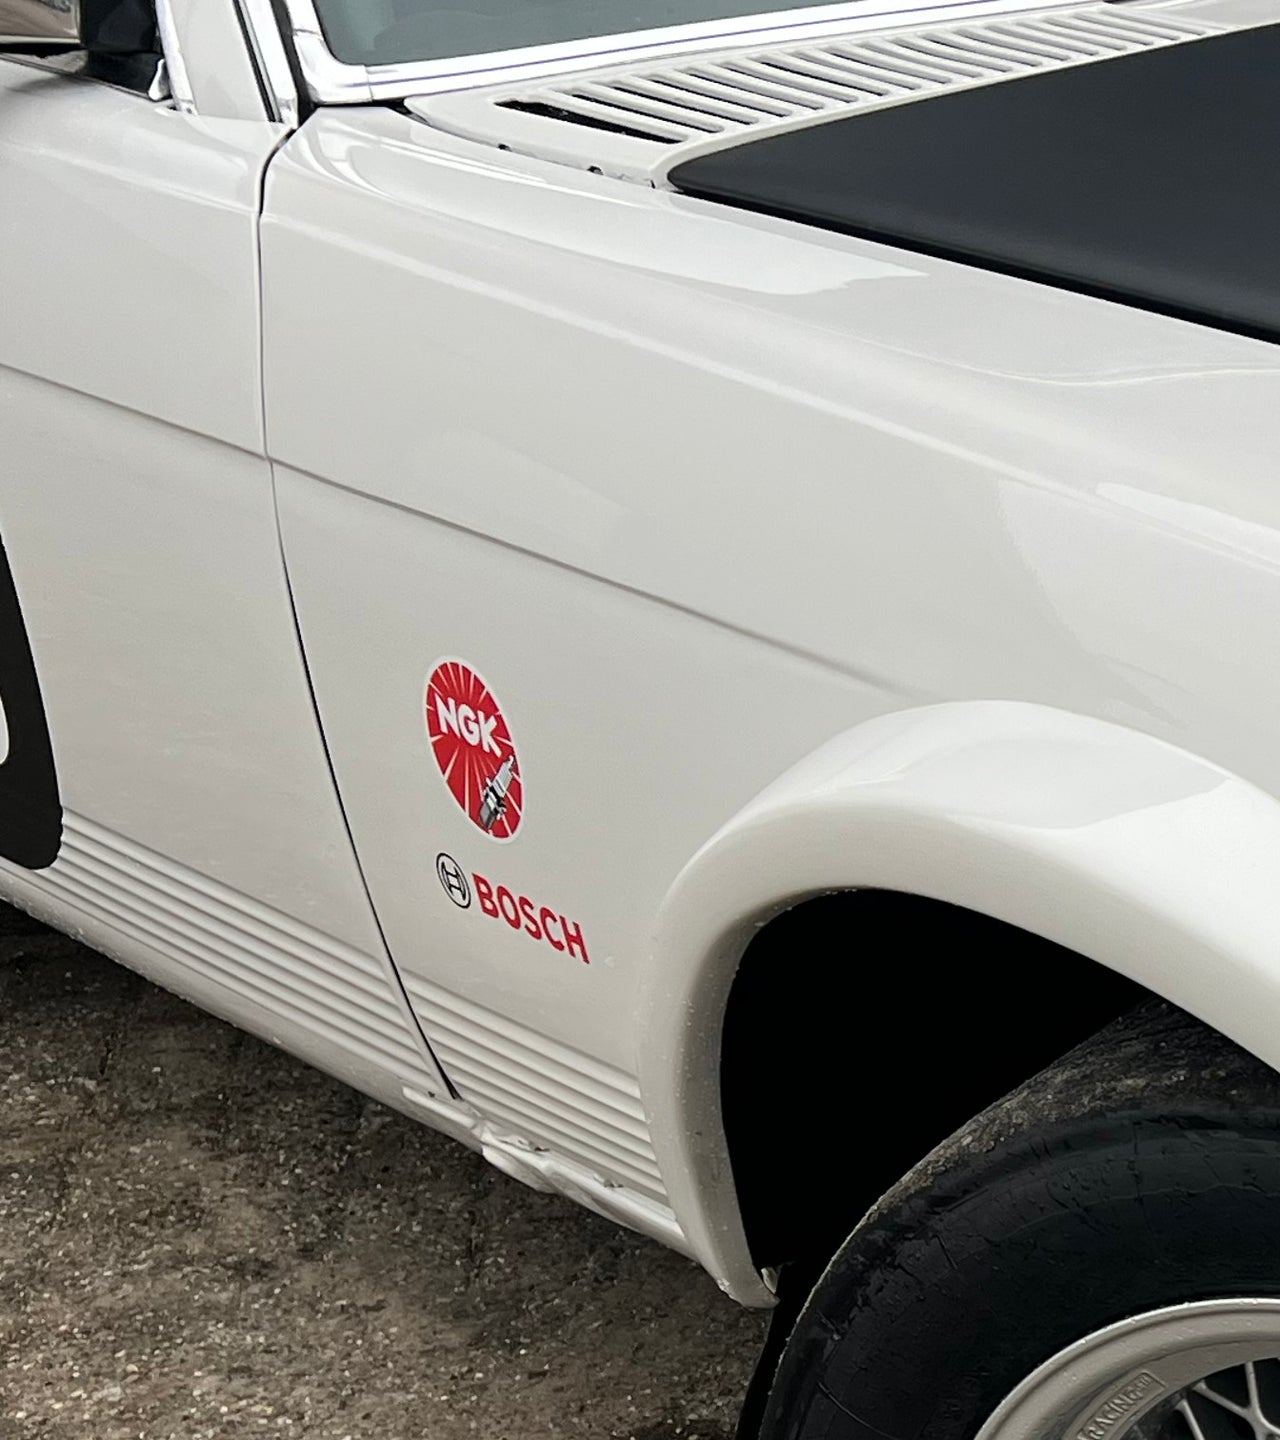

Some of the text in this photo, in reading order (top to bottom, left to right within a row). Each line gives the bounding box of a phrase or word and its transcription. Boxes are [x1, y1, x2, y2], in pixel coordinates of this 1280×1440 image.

[435, 693, 502, 758] NGK
[471, 872, 590, 964] BOSCH
[1086, 1387, 1143, 1440] RACING
